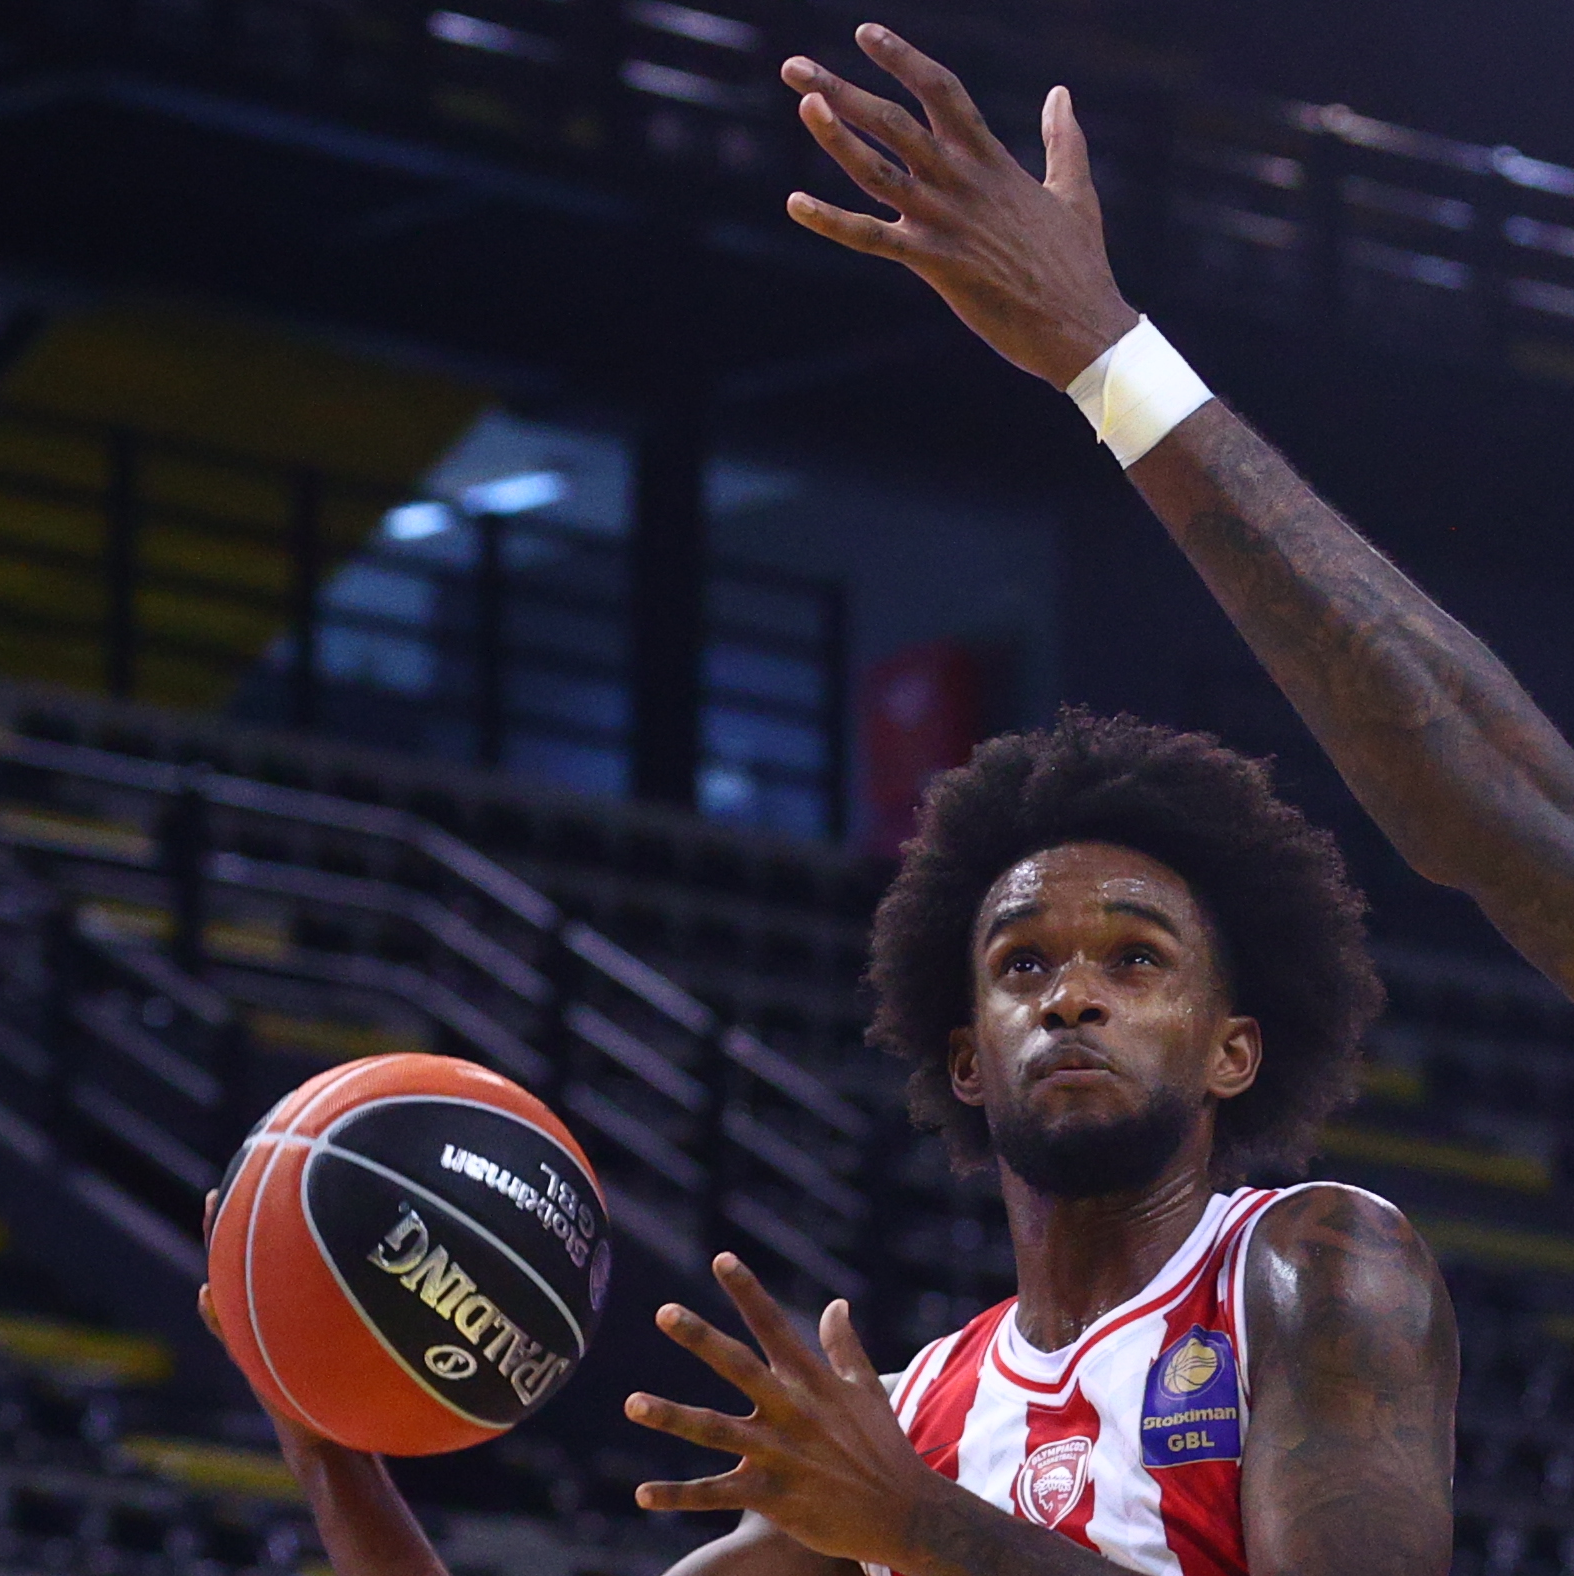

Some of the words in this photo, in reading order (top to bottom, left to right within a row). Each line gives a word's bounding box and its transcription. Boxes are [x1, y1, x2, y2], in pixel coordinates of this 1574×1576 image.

[540, 1162, 595, 1239] GBL
[366, 1209, 570, 1406] SPALDING
[1167, 1431, 1215, 1452] GBL
